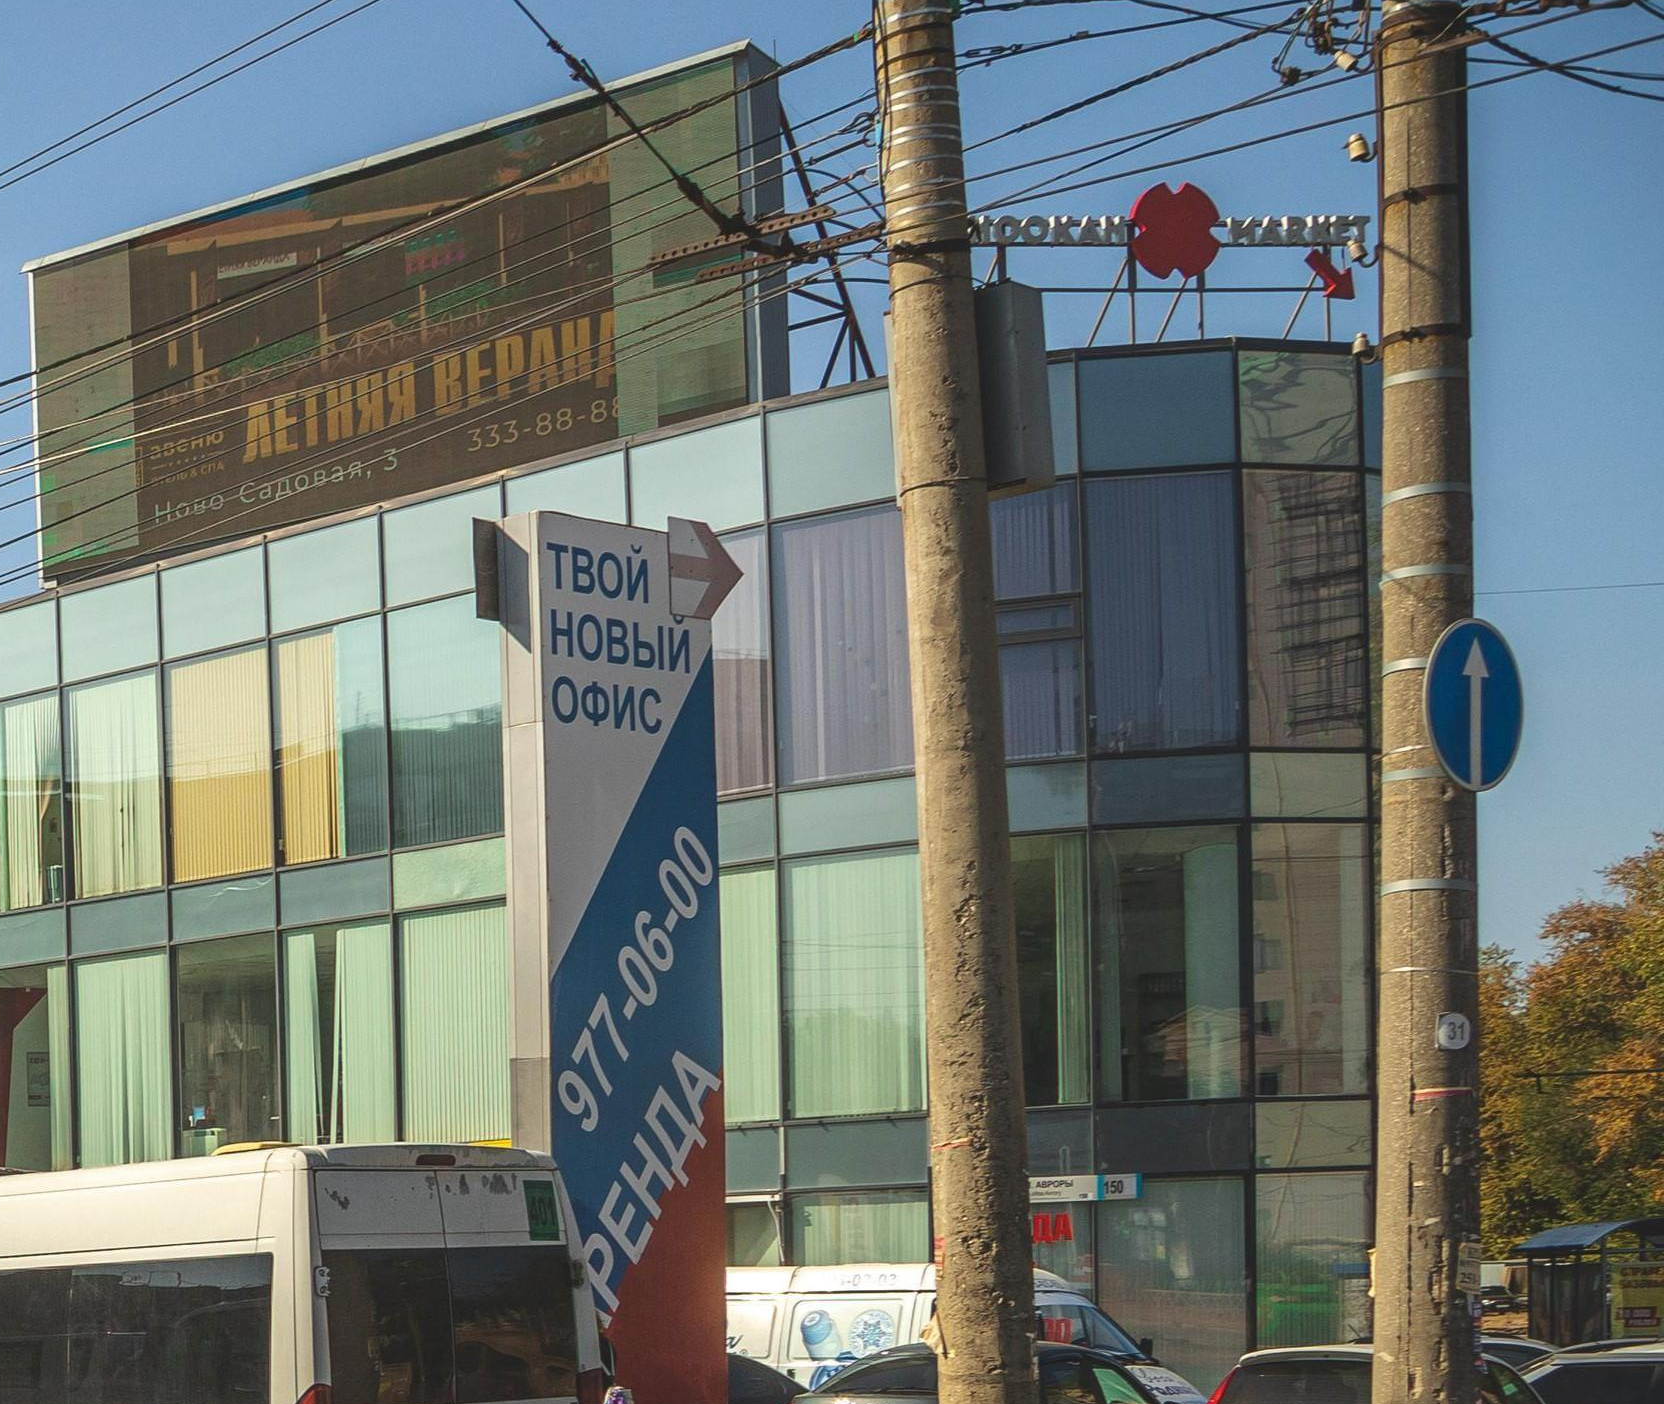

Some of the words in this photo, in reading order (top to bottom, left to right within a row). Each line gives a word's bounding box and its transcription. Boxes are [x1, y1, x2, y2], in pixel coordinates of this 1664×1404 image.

[1225, 214, 1371, 244] MARKET
[243, 361, 417, 464] ЛЕТНЯЯ
[383, 448, 399, 471] 3
[546, 541, 650, 604] ТВОЙ
[550, 609, 691, 674] НОВЫЙ
[551, 676, 663, 735] ОФИС
[557, 826, 714, 1133] 977-06-00
[1448, 1021, 1465, 1040] 31
[584, 1050, 723, 1330] РЕНДА
[1035, 1180, 1074, 1189] АВРОРЫ
[1104, 1180, 1124, 1194] 150
